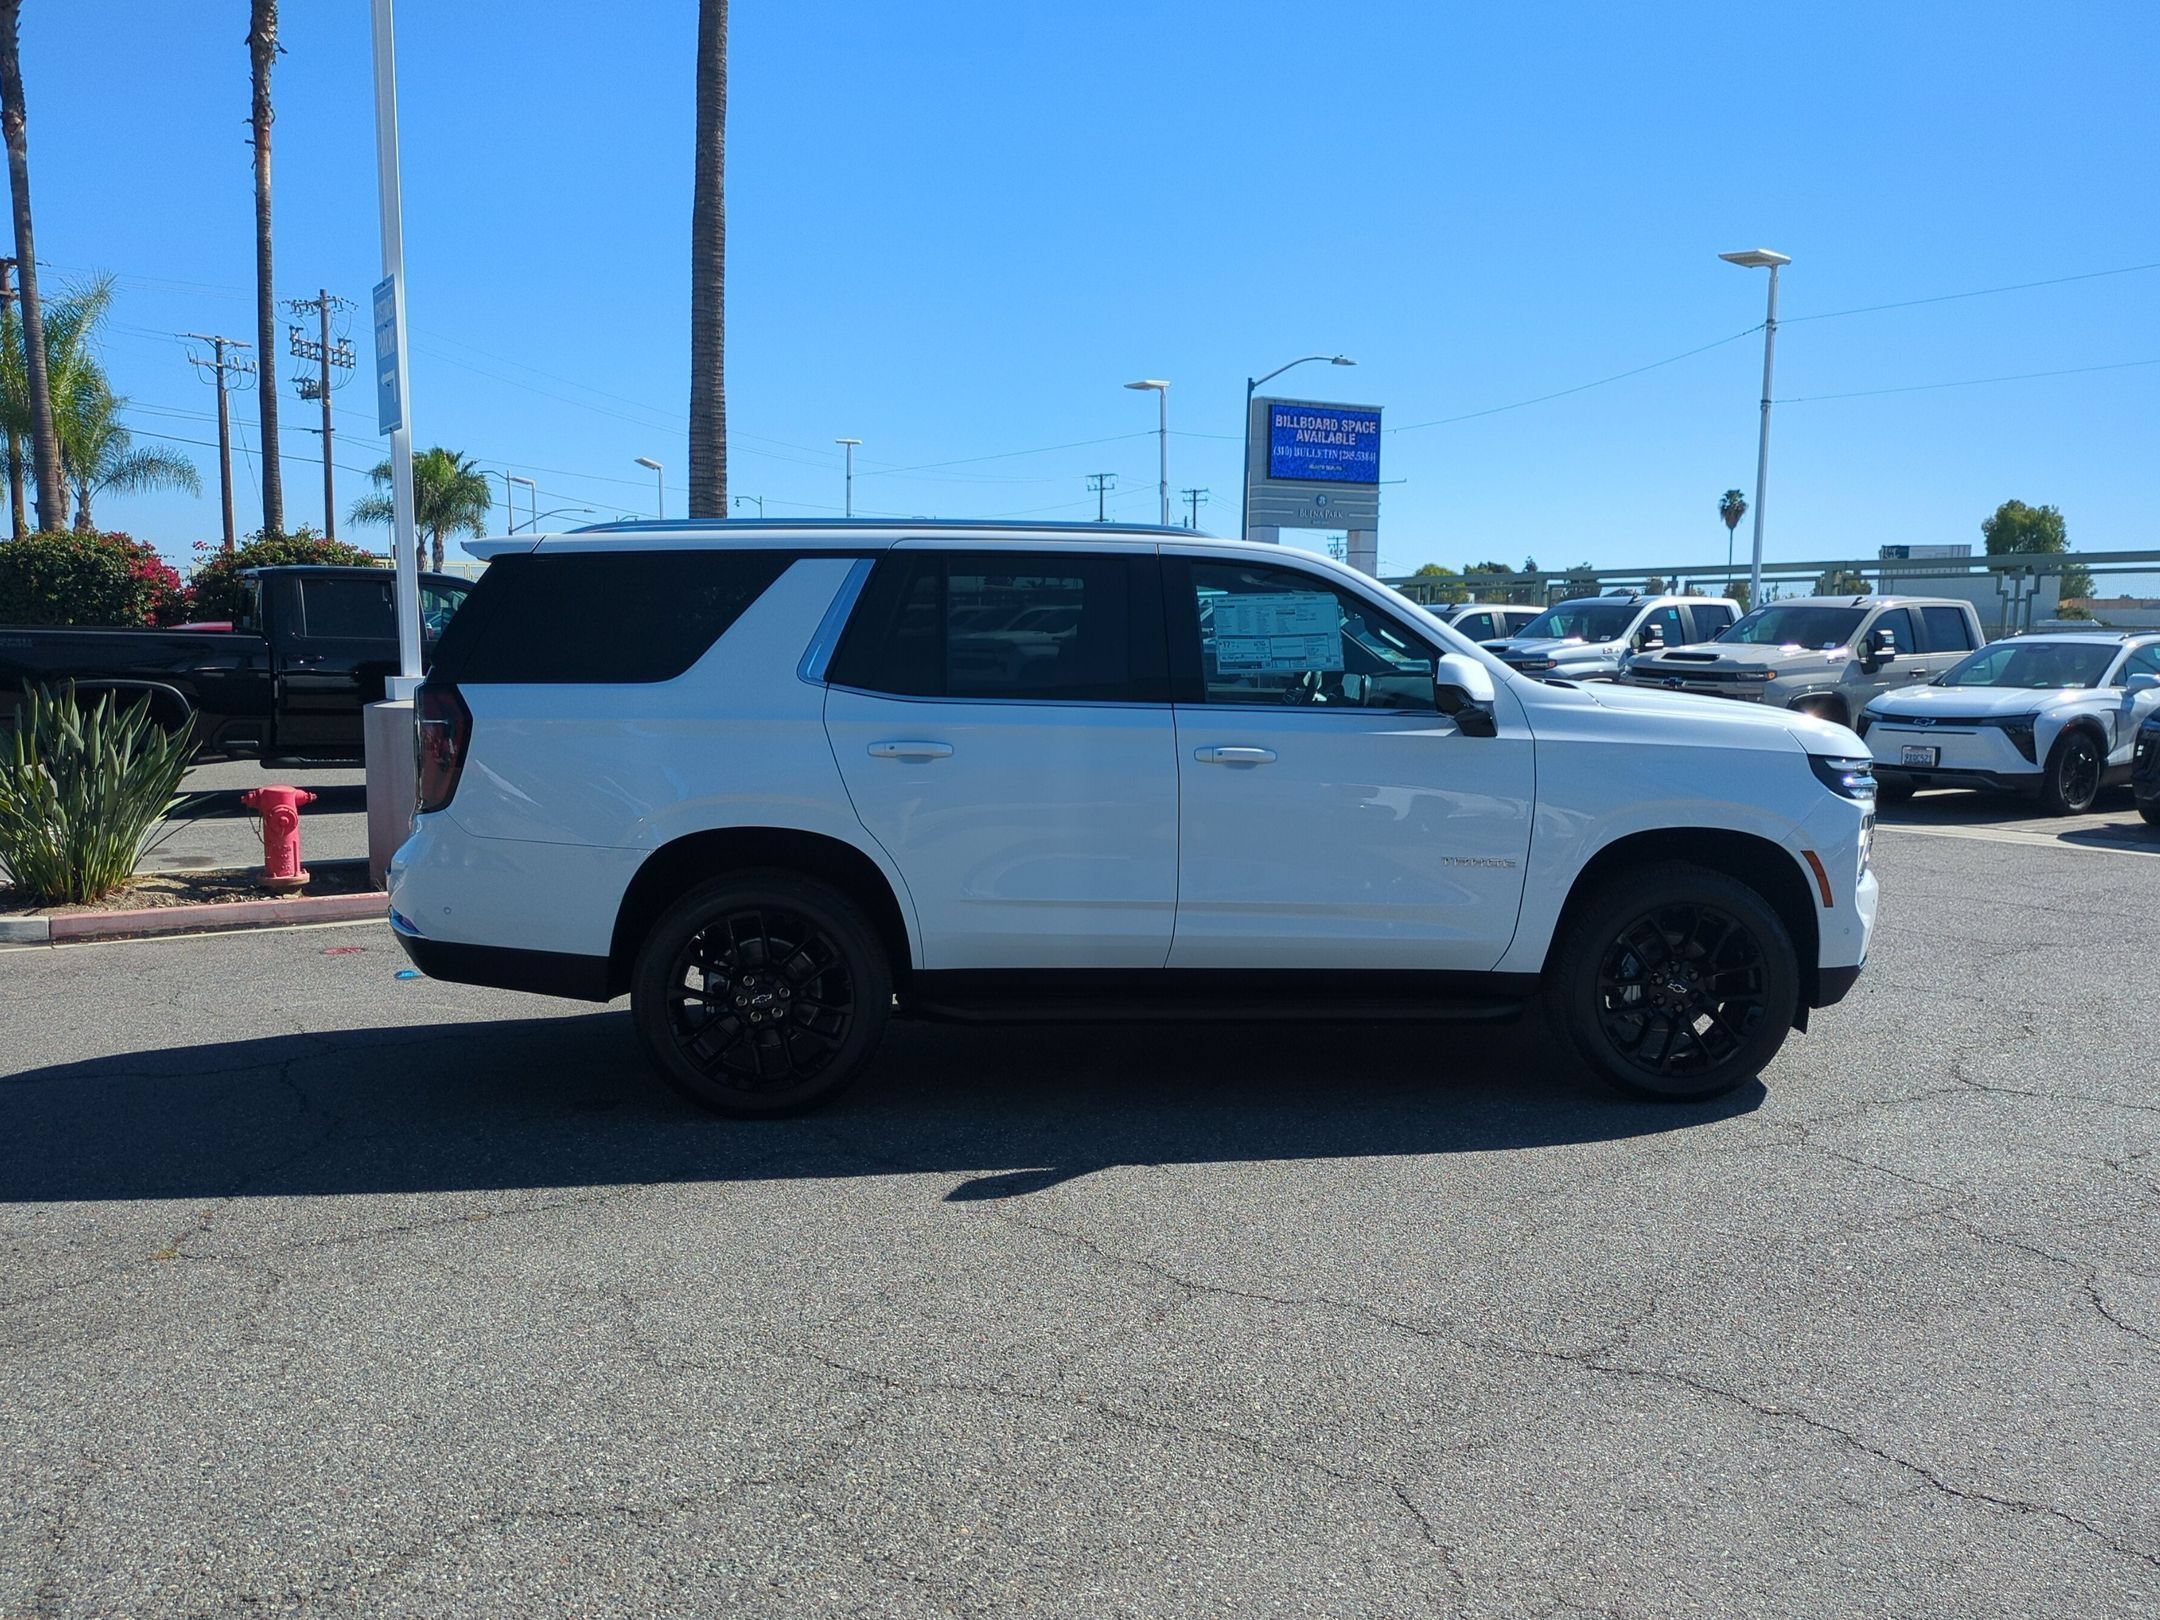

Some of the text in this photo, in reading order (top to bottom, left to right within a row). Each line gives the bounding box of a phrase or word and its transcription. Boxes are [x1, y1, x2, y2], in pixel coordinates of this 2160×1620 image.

[1275, 414, 1377, 434] BILLBOARD SPACE
[1295, 429, 1356, 446] AVAILABLE
[1273, 445, 1293, 458] (310)
[1294, 447, 1339, 460] BULLETIN
